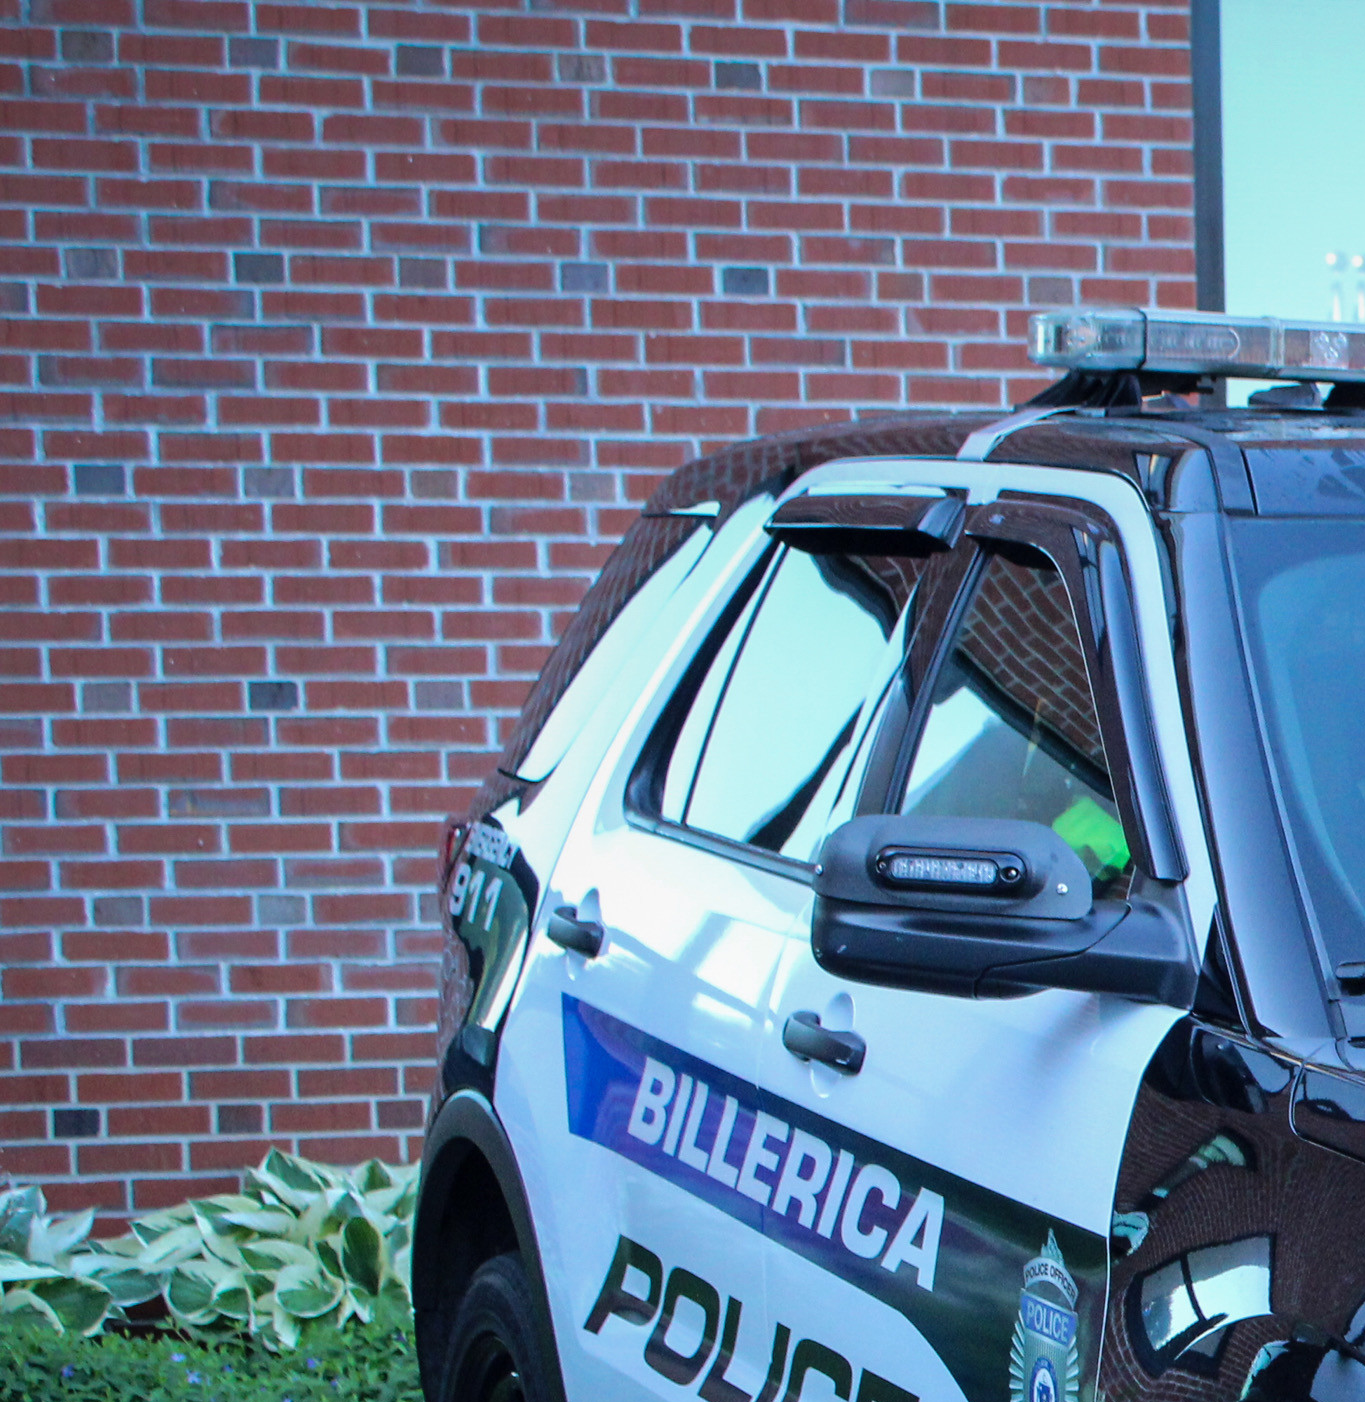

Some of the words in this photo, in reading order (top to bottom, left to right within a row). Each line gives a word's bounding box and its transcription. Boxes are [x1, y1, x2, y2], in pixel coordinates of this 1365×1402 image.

[449, 862, 504, 933] 911
[627, 1056, 945, 1293] BILLERICA
[1025, 1262, 1049, 1280] POLICE
[1049, 1264, 1077, 1299] OFFICER
[1026, 1300, 1070, 1342] POLICE
